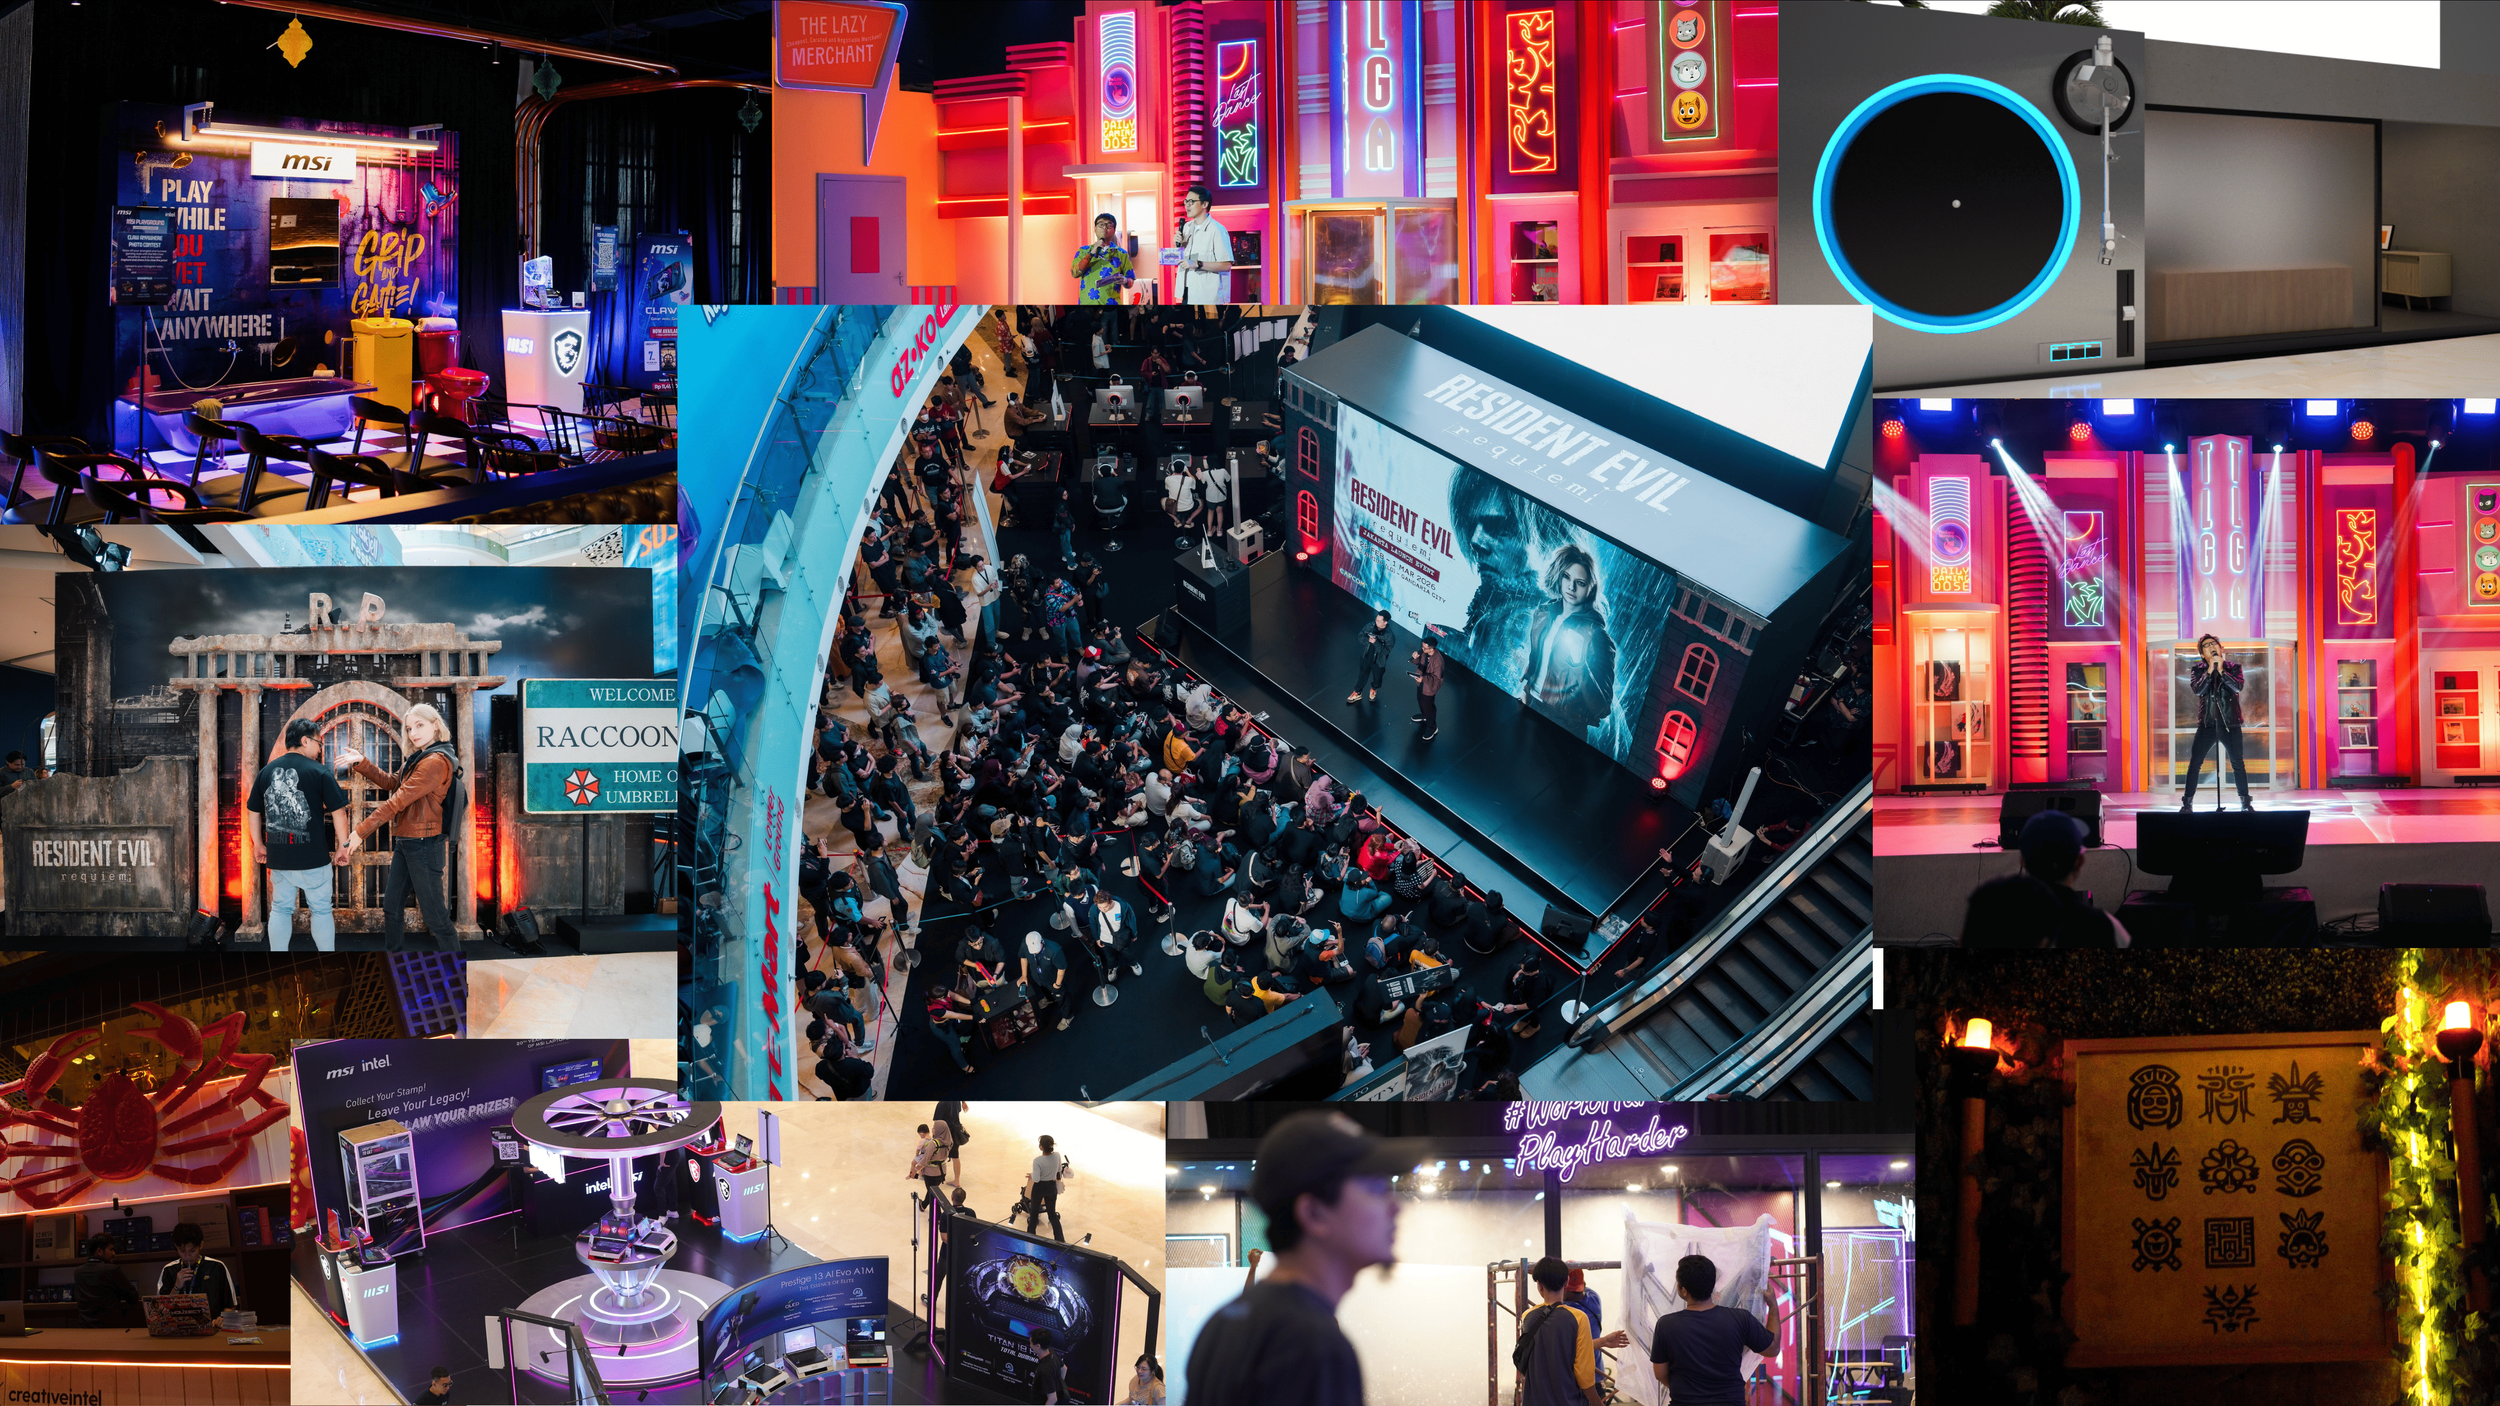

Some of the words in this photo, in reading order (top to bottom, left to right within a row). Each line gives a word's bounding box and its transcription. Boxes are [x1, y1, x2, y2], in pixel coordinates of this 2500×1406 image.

[799, 16, 828, 36] THE
[832, 15, 868, 34] LAZY
[792, 44, 874, 67] MERCHANT
[1228, 72, 1261, 103] Last
[1212, 92, 1262, 128] Dance
[1103, 119, 1135, 130] DAILY
[1103, 129, 1135, 138] GAMING
[1103, 137, 1135, 149] DOSE
[162, 178, 214, 204] PLAY
[176, 233, 204, 257] OU
[175, 261, 207, 285] ET
[645, 306, 678, 315] CLAW
[160, 314, 273, 341] ANYWHERE
[1422, 373, 1611, 467] RESIDENT
[1585, 449, 1691, 513] EVIL
[1351, 477, 1419, 537] RESIDENT
[1421, 517, 1454, 559] EVIL
[2074, 537, 2108, 561] Last
[1371, 547, 1385, 560] FEB
[1398, 564, 1415, 578] MAR
[1416, 575, 1436, 591] 2026
[1932, 566, 1970, 575] DAILY
[2058, 552, 2109, 579] Dance
[1339, 567, 1366, 588] CAPCOM
[1932, 574, 1970, 582] GAMING
[1932, 581, 1970, 591] DOSE
[1431, 592, 1446, 604] CITY
[589, 687, 676, 703] WELCOME
[536, 725, 678, 749] RACCOON
[613, 770, 662, 784] HOME
[32, 839, 112, 867] RESIDENT
[117, 839, 155, 867] EVIL
[345, 1094, 375, 1109] Collect
[375, 1089, 395, 1103] Your
[396, 1083, 427, 1100] Stamp!
[368, 1103, 400, 1121] Leave
[403, 1099, 427, 1113] Your
[429, 1087, 471, 1106] Legacy!
[1353, 1086, 1369, 1099] TO
[433, 1107, 467, 1125] YOUR
[468, 1096, 515, 1117] PRIZES!
[585, 1177, 612, 1195] intel
[780, 1275, 812, 1289] Prestige
[814, 1272, 824, 1281] 13
[835, 1269, 852, 1277] Evo
[853, 1266, 875, 1275] A1M
[987, 1333, 1015, 1349] TITAN
[1000, 1346, 1017, 1357] TOTAL
[8, 1388, 102, 1406] creativeintel
